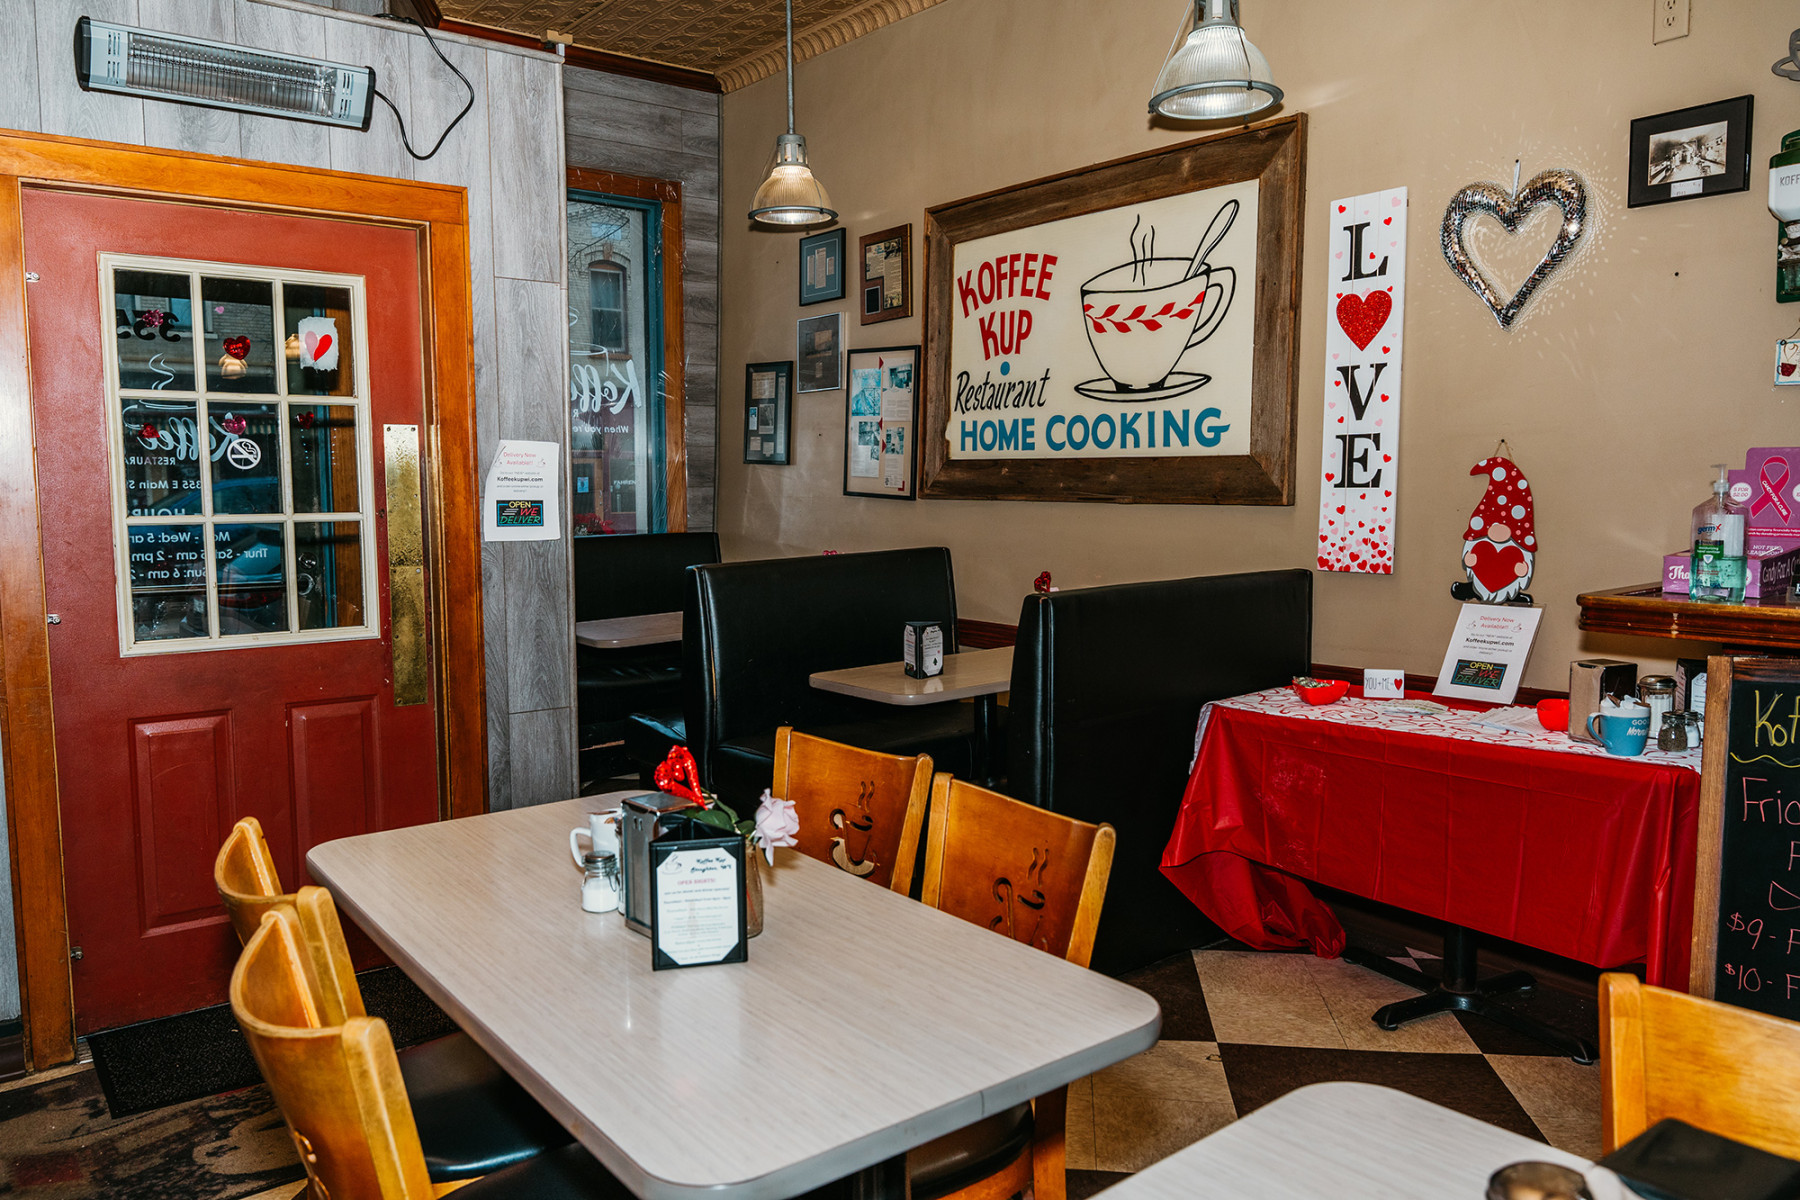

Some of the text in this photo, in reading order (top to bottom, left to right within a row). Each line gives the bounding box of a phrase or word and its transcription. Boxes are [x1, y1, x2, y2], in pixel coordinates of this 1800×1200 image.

[957, 253, 1058, 318] KOFFEE
[979, 309, 1033, 361] KUP
[1333, 222, 1389, 488] LVE
[954, 368, 1050, 414] Restaurant
[960, 407, 1231, 451] HOME COOKING
[500, 516, 540, 524] DELIVER
[520, 508, 538, 516] WE
[1455, 674, 1499, 686] DELIVER
[1470, 662, 1494, 670] OPEN
[1479, 669, 1500, 679] WE
[1727, 912, 1763, 950] $9
[1725, 963, 1761, 992] $10
